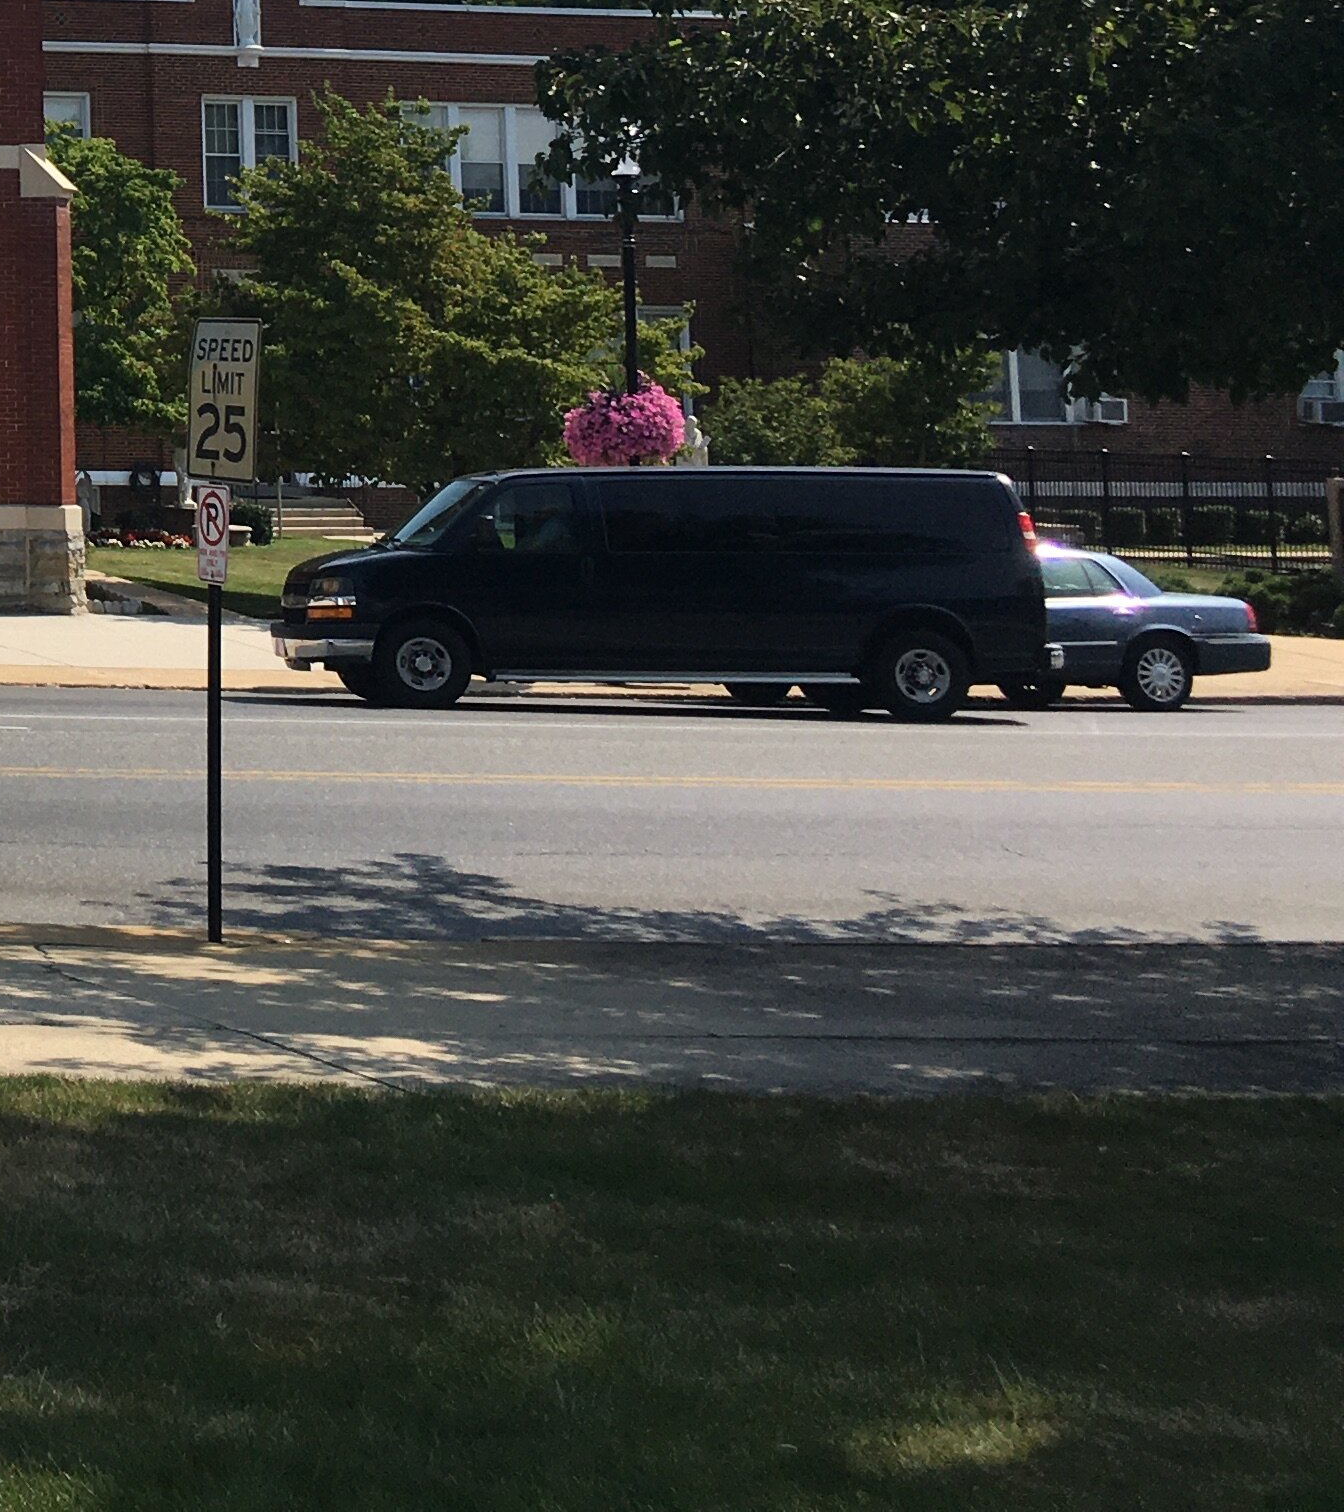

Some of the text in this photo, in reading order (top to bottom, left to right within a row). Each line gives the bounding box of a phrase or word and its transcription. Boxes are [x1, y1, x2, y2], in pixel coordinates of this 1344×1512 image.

[196, 338, 254, 362] SPEED
[201, 369, 245, 396] LIMIT
[195, 402, 247, 463] 25
